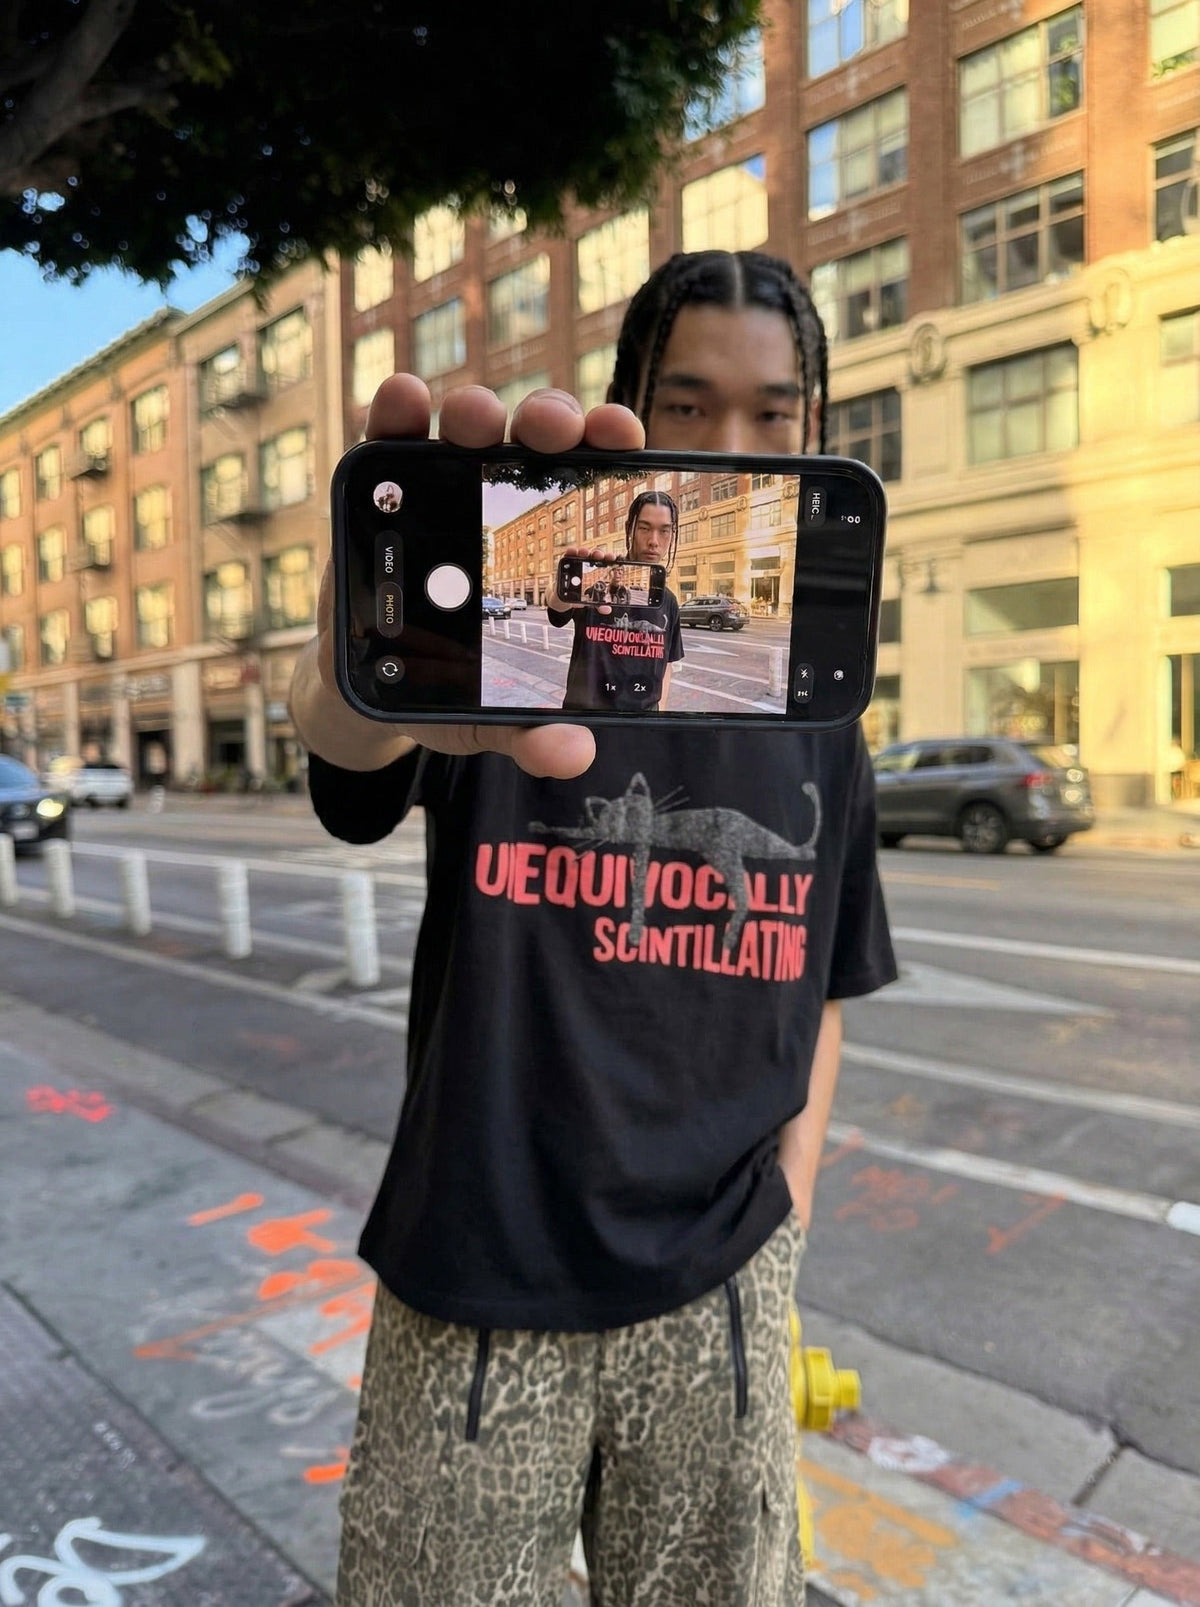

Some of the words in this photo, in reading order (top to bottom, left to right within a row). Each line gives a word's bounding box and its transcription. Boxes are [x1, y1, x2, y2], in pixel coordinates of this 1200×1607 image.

[811, 493, 820, 514] HEIC
[384, 546, 394, 574] VIDEO
[385, 594, 394, 624] PHOTO
[605, 683, 616, 692] 1x
[634, 683, 646, 692] 2x
[593, 917, 807, 982] SCINTILLATING
